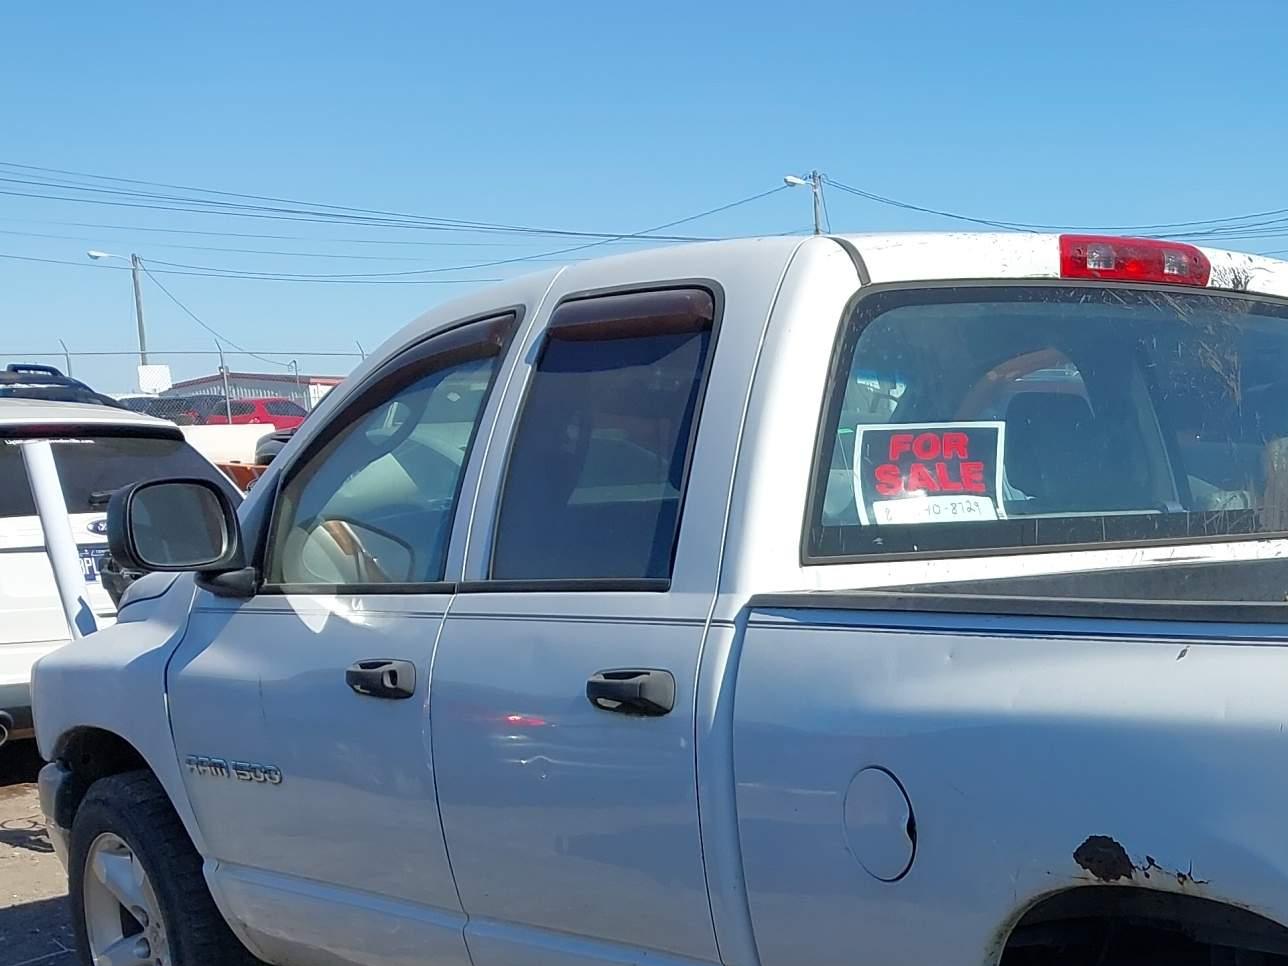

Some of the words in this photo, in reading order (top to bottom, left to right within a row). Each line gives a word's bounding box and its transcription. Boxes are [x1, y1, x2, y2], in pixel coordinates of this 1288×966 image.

[890, 432, 969, 460] FOR
[874, 461, 986, 495] SALE
[230, 760, 283, 785] 1500
